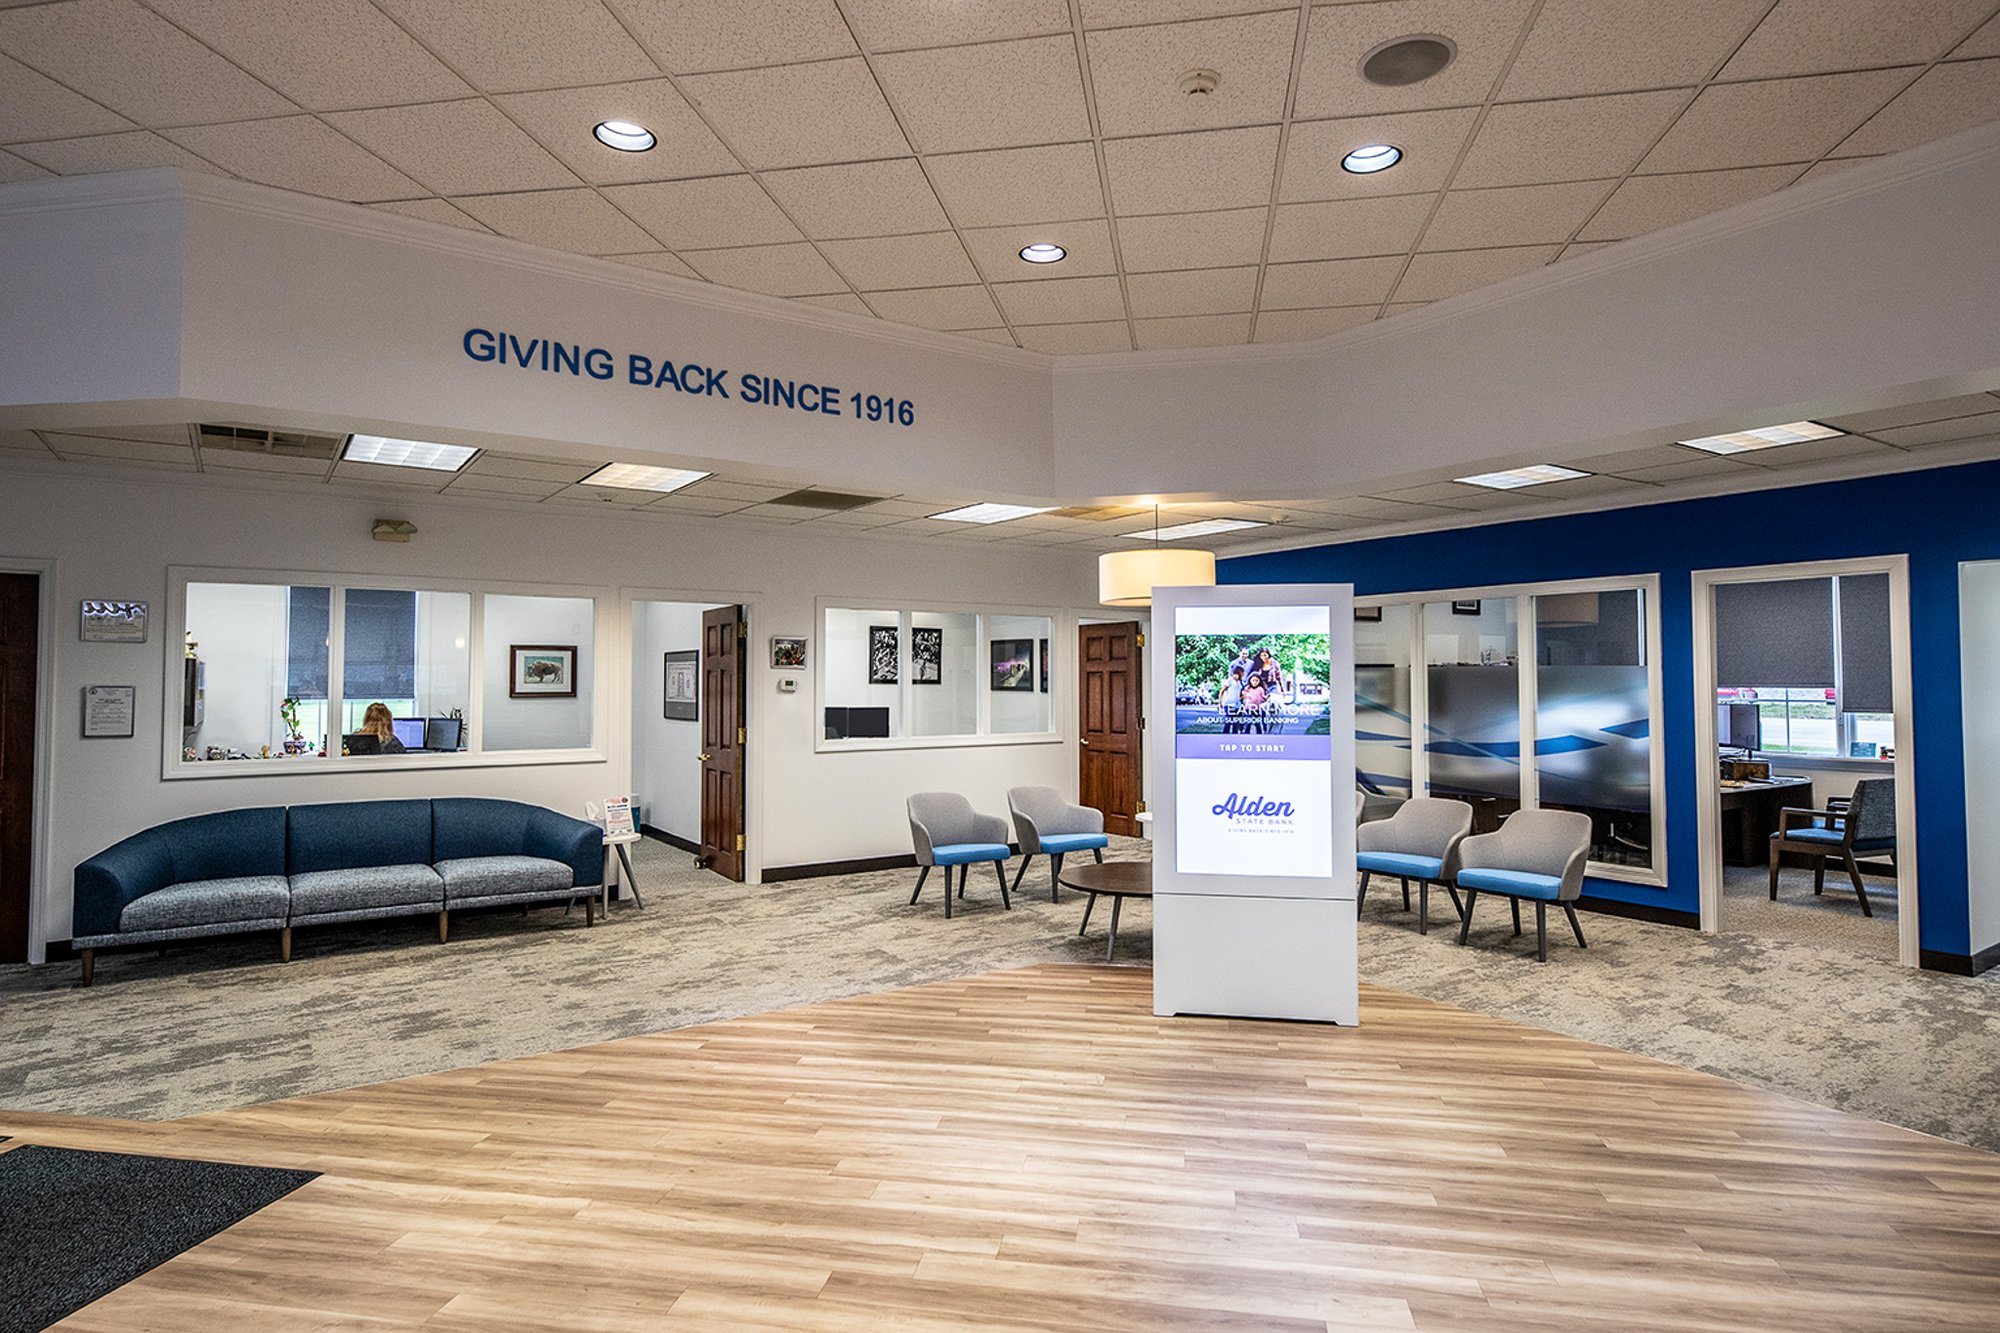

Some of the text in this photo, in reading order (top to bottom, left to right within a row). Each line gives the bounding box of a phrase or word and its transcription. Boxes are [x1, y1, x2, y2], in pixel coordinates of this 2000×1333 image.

[463, 328, 914, 427] GIVING BACK SINCE 1916
[1219, 703, 1321, 716] LEARN MORE
[1197, 716, 1299, 725] ABOUT SUPERIOR BANKING
[1219, 743, 1286, 753] TAP TO START
[1212, 792, 1296, 820] Alden
